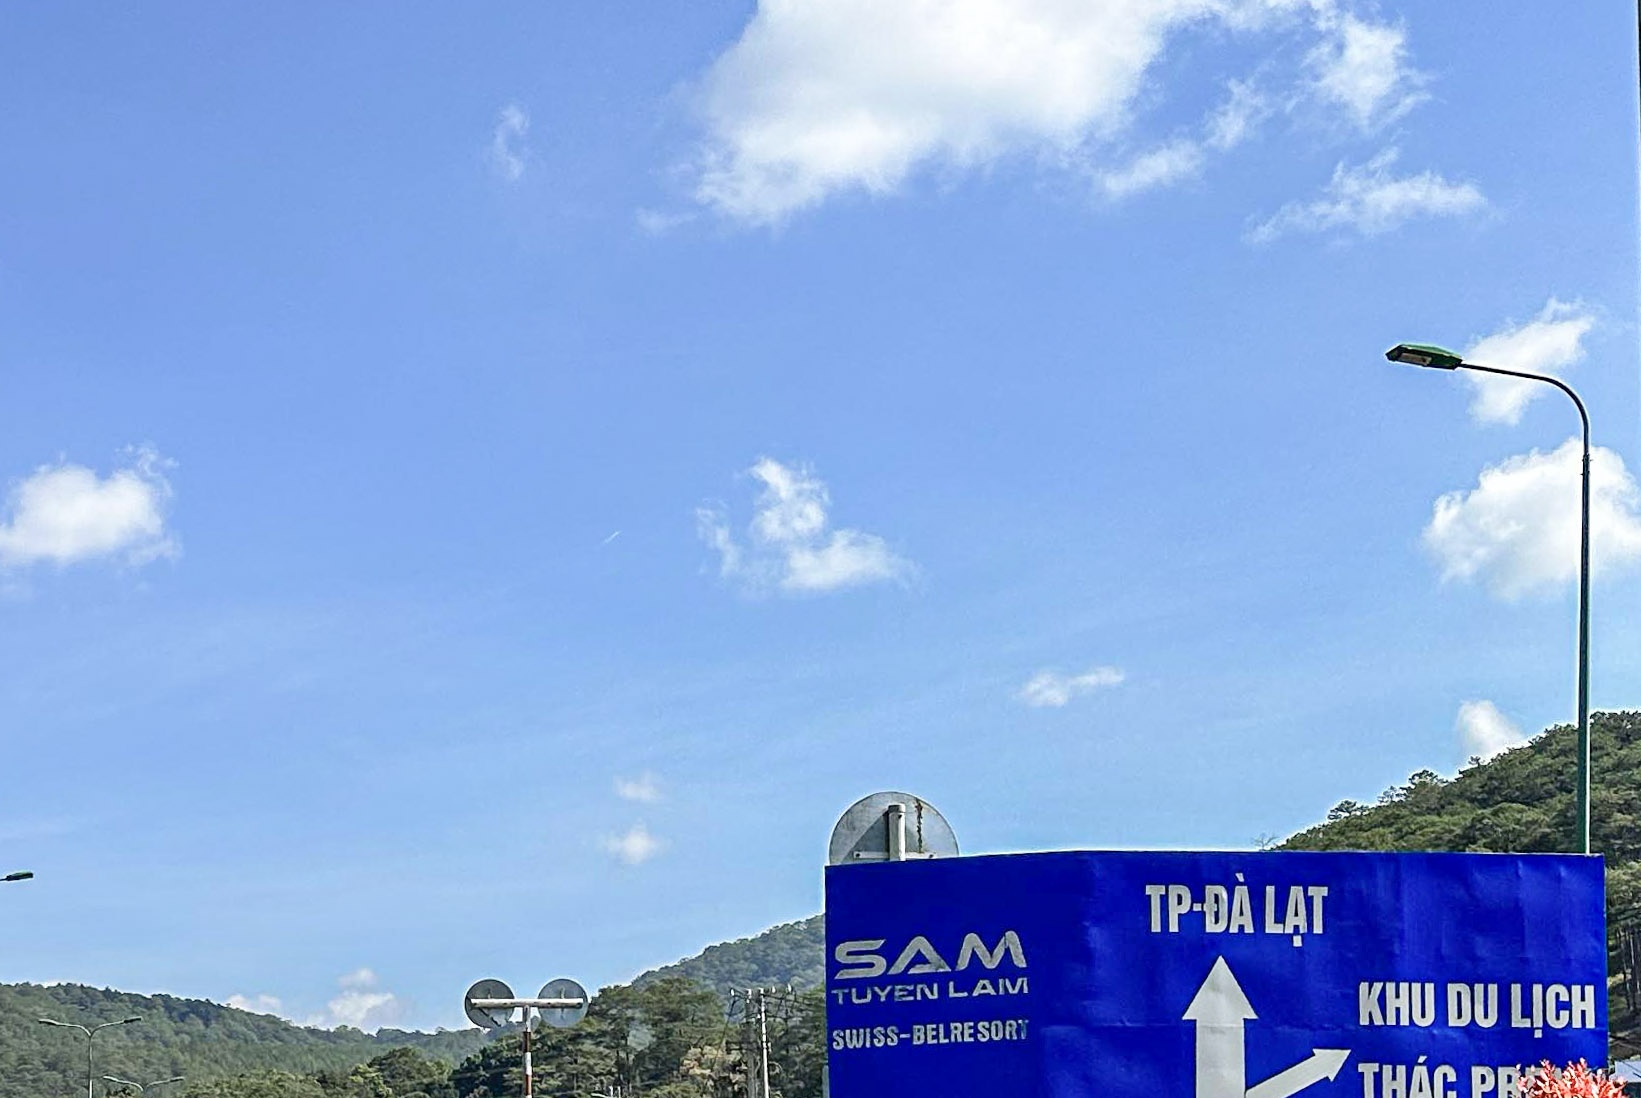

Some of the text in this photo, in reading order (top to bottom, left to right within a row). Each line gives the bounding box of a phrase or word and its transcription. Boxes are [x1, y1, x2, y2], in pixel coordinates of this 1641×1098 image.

[1265, 885, 1329, 947] LẠT
[834, 930, 1027, 980] SAM
[831, 977, 1029, 1005] TUYEN LAM
[1358, 981, 1596, 1039] KHU DU LỊCH
